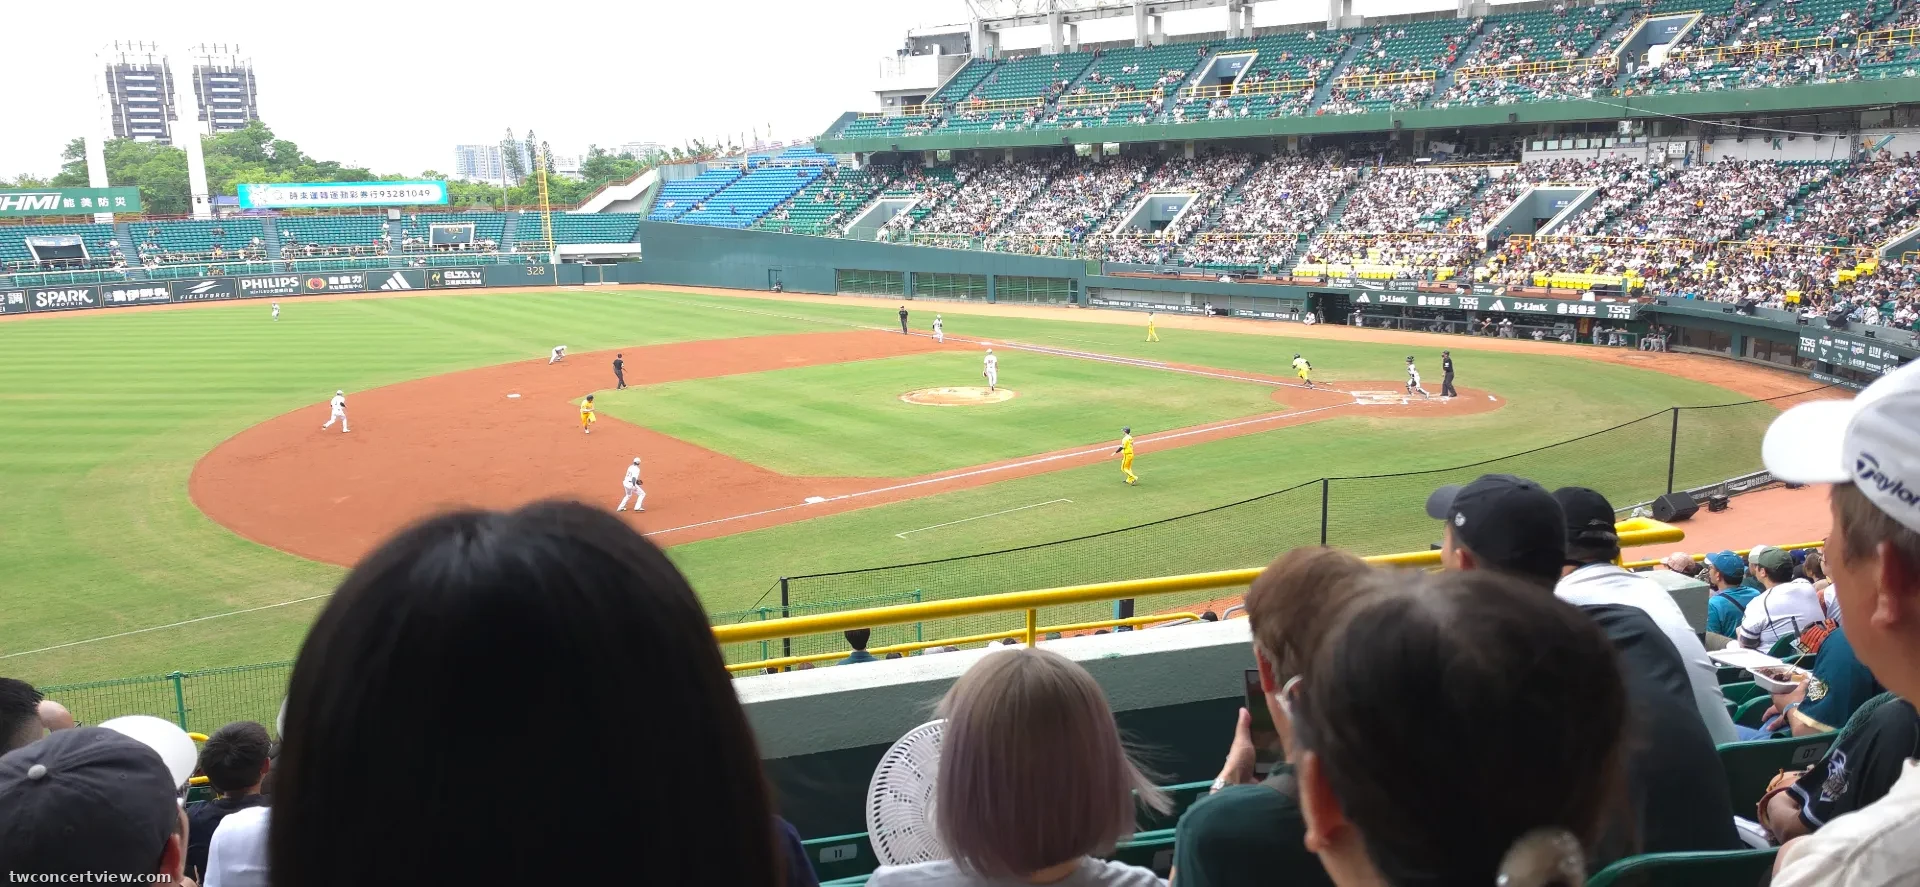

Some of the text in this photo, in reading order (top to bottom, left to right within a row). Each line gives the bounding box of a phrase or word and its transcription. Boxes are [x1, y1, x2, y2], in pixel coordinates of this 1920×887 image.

[526, 266, 545, 276] 328
[241, 277, 300, 290] PHILIPS
[35, 289, 93, 307] SPARK
[180, 292, 230, 300] FIELDFORGE
[1379, 294, 1408, 304] D-Link
[1457, 296, 1479, 305] TSG
[1513, 302, 1548, 312] D-Link
[1606, 304, 1631, 314] TSG
[1800, 336, 1816, 348] TSG
[1803, 748, 1817, 759] 07
[834, 849, 843, 858] 11
